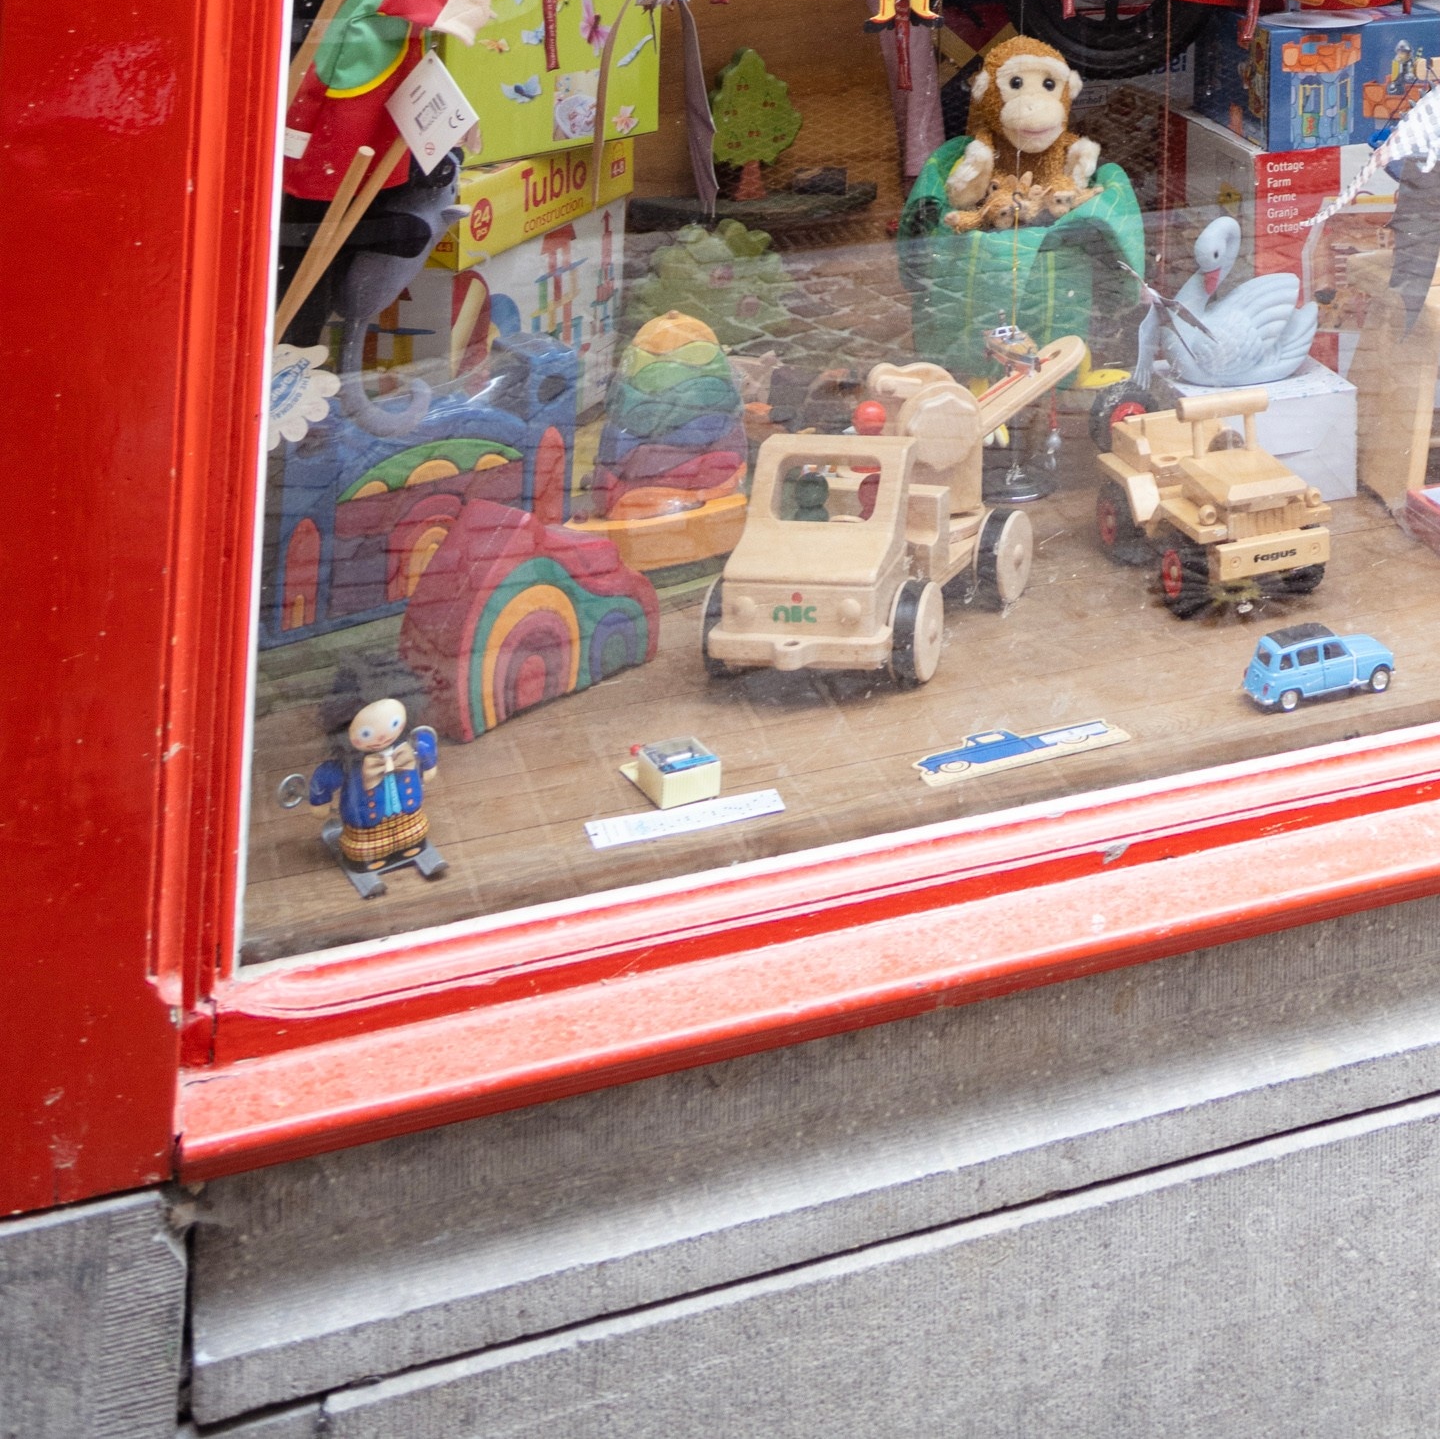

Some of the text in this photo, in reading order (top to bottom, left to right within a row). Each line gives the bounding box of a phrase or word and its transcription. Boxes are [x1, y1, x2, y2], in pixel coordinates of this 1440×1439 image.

[1267, 162, 1304, 173] Cottage
[1267, 178, 1291, 188] Farm
[1267, 192, 1297, 203] Ferme
[472, 208, 490, 228] 24
[1267, 206, 1298, 219] Granja
[1253, 548, 1297, 563] fagus
[772, 592, 817, 623] nic
